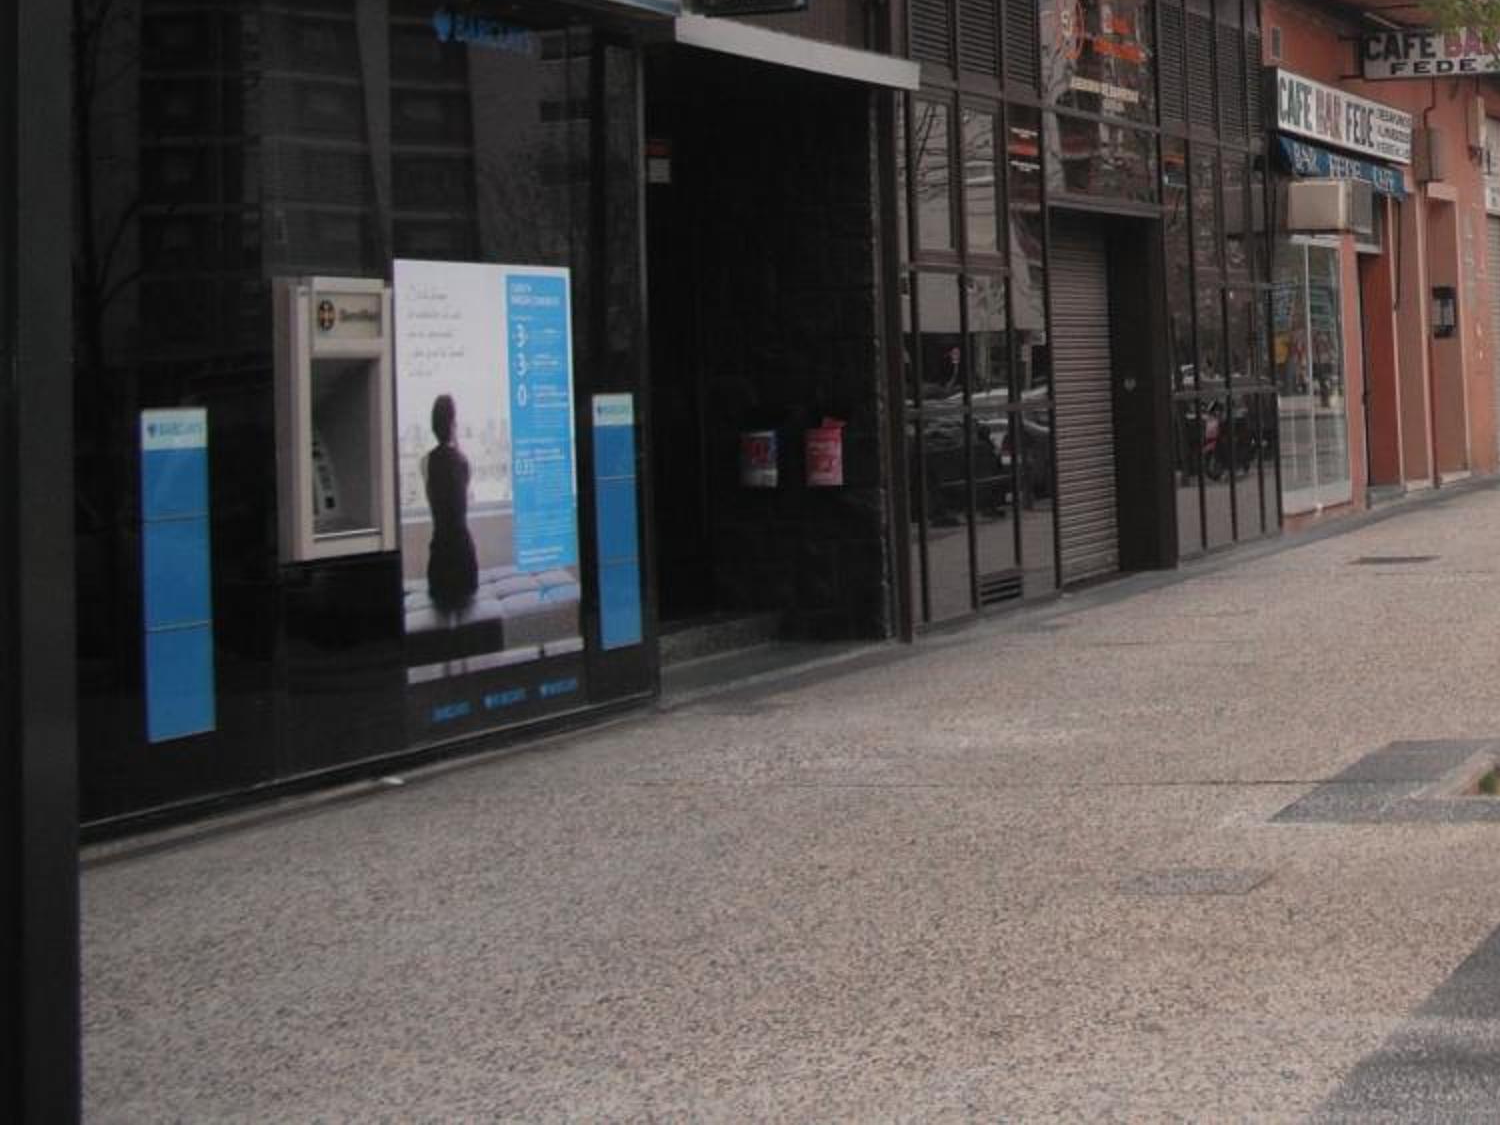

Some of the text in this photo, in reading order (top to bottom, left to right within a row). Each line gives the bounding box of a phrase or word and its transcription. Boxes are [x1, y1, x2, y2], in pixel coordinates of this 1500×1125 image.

[1391, 58, 1477, 75] FEDE
[1279, 75, 1375, 149] CAFE BAR FEDE
